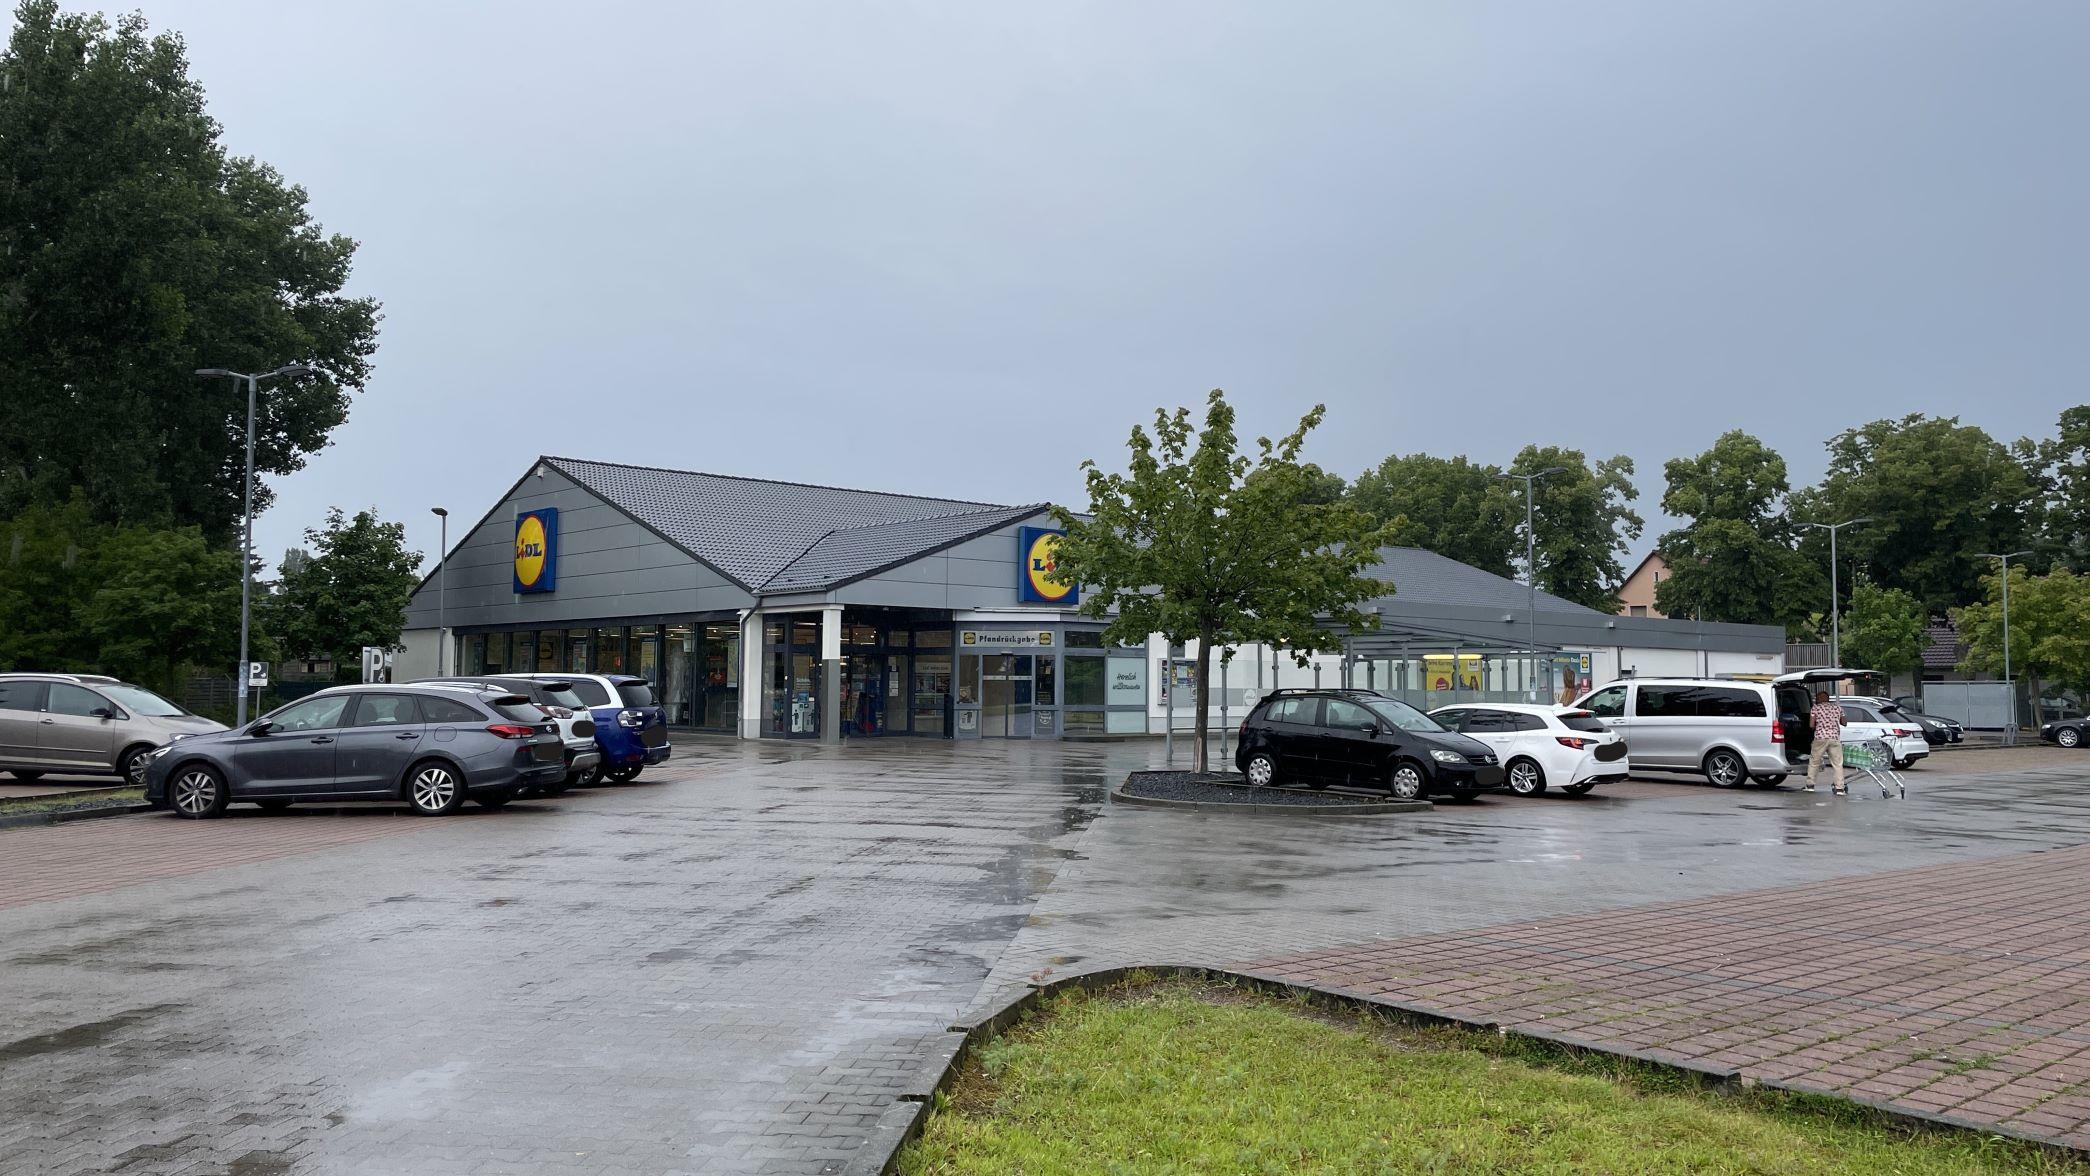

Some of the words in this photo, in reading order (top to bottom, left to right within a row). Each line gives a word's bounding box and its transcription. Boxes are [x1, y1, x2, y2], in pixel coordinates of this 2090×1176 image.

[979, 635, 1036, 644] Pfandrückgabe
[250, 662, 262, 679] P
[370, 648, 384, 682] P
